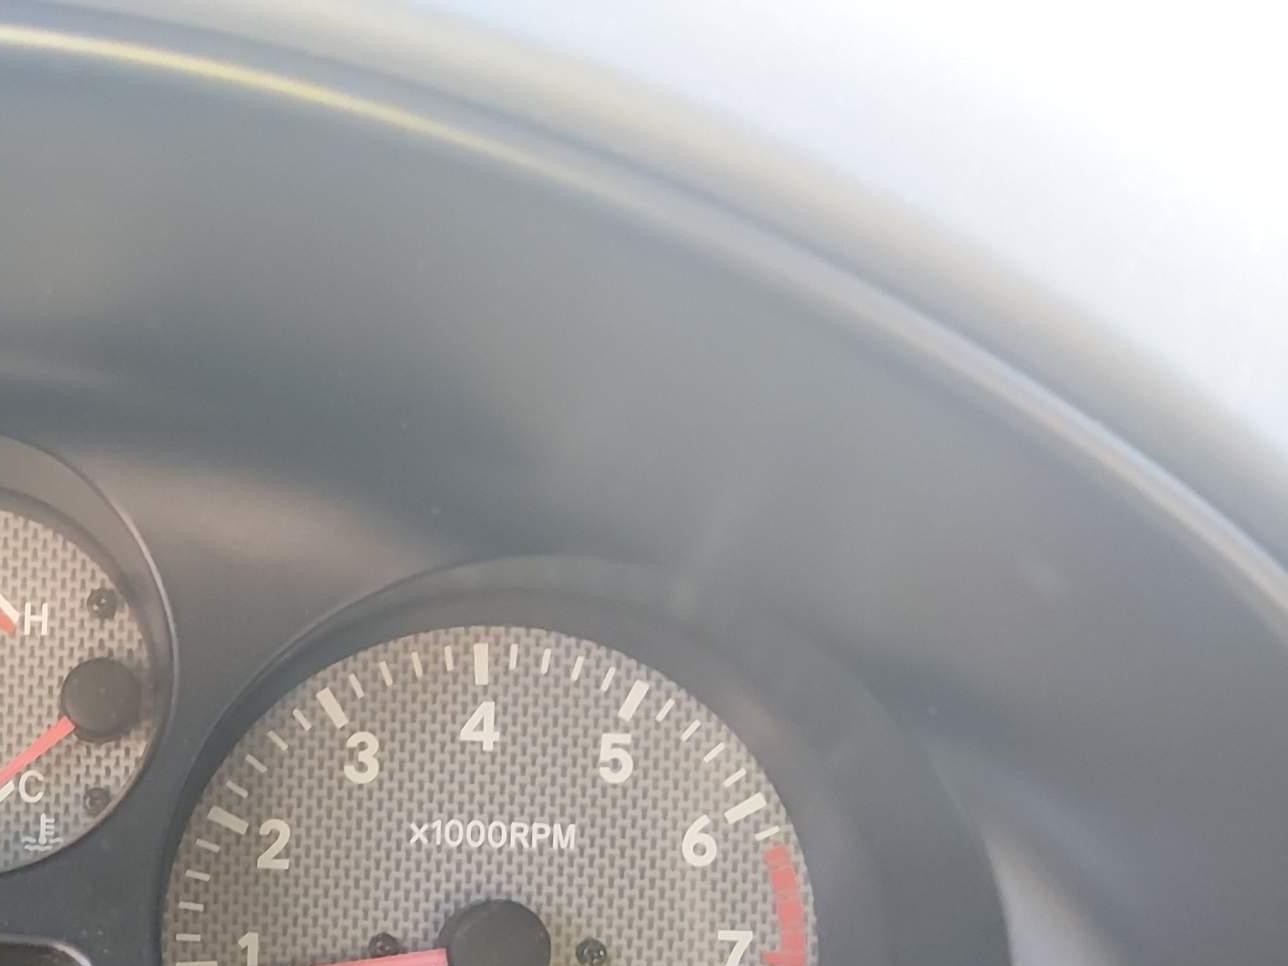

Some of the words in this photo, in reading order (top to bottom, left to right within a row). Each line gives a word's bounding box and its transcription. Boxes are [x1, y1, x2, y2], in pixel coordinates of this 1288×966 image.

[23, 602, 49, 637] H
[459, 700, 501, 752] 4
[343, 731, 381, 785] 3
[598, 732, 634, 784] 5
[18, 769, 44, 804] C
[256, 818, 290, 871] 2
[408, 819, 577, 852] x1000RPM
[681, 814, 718, 868] 6
